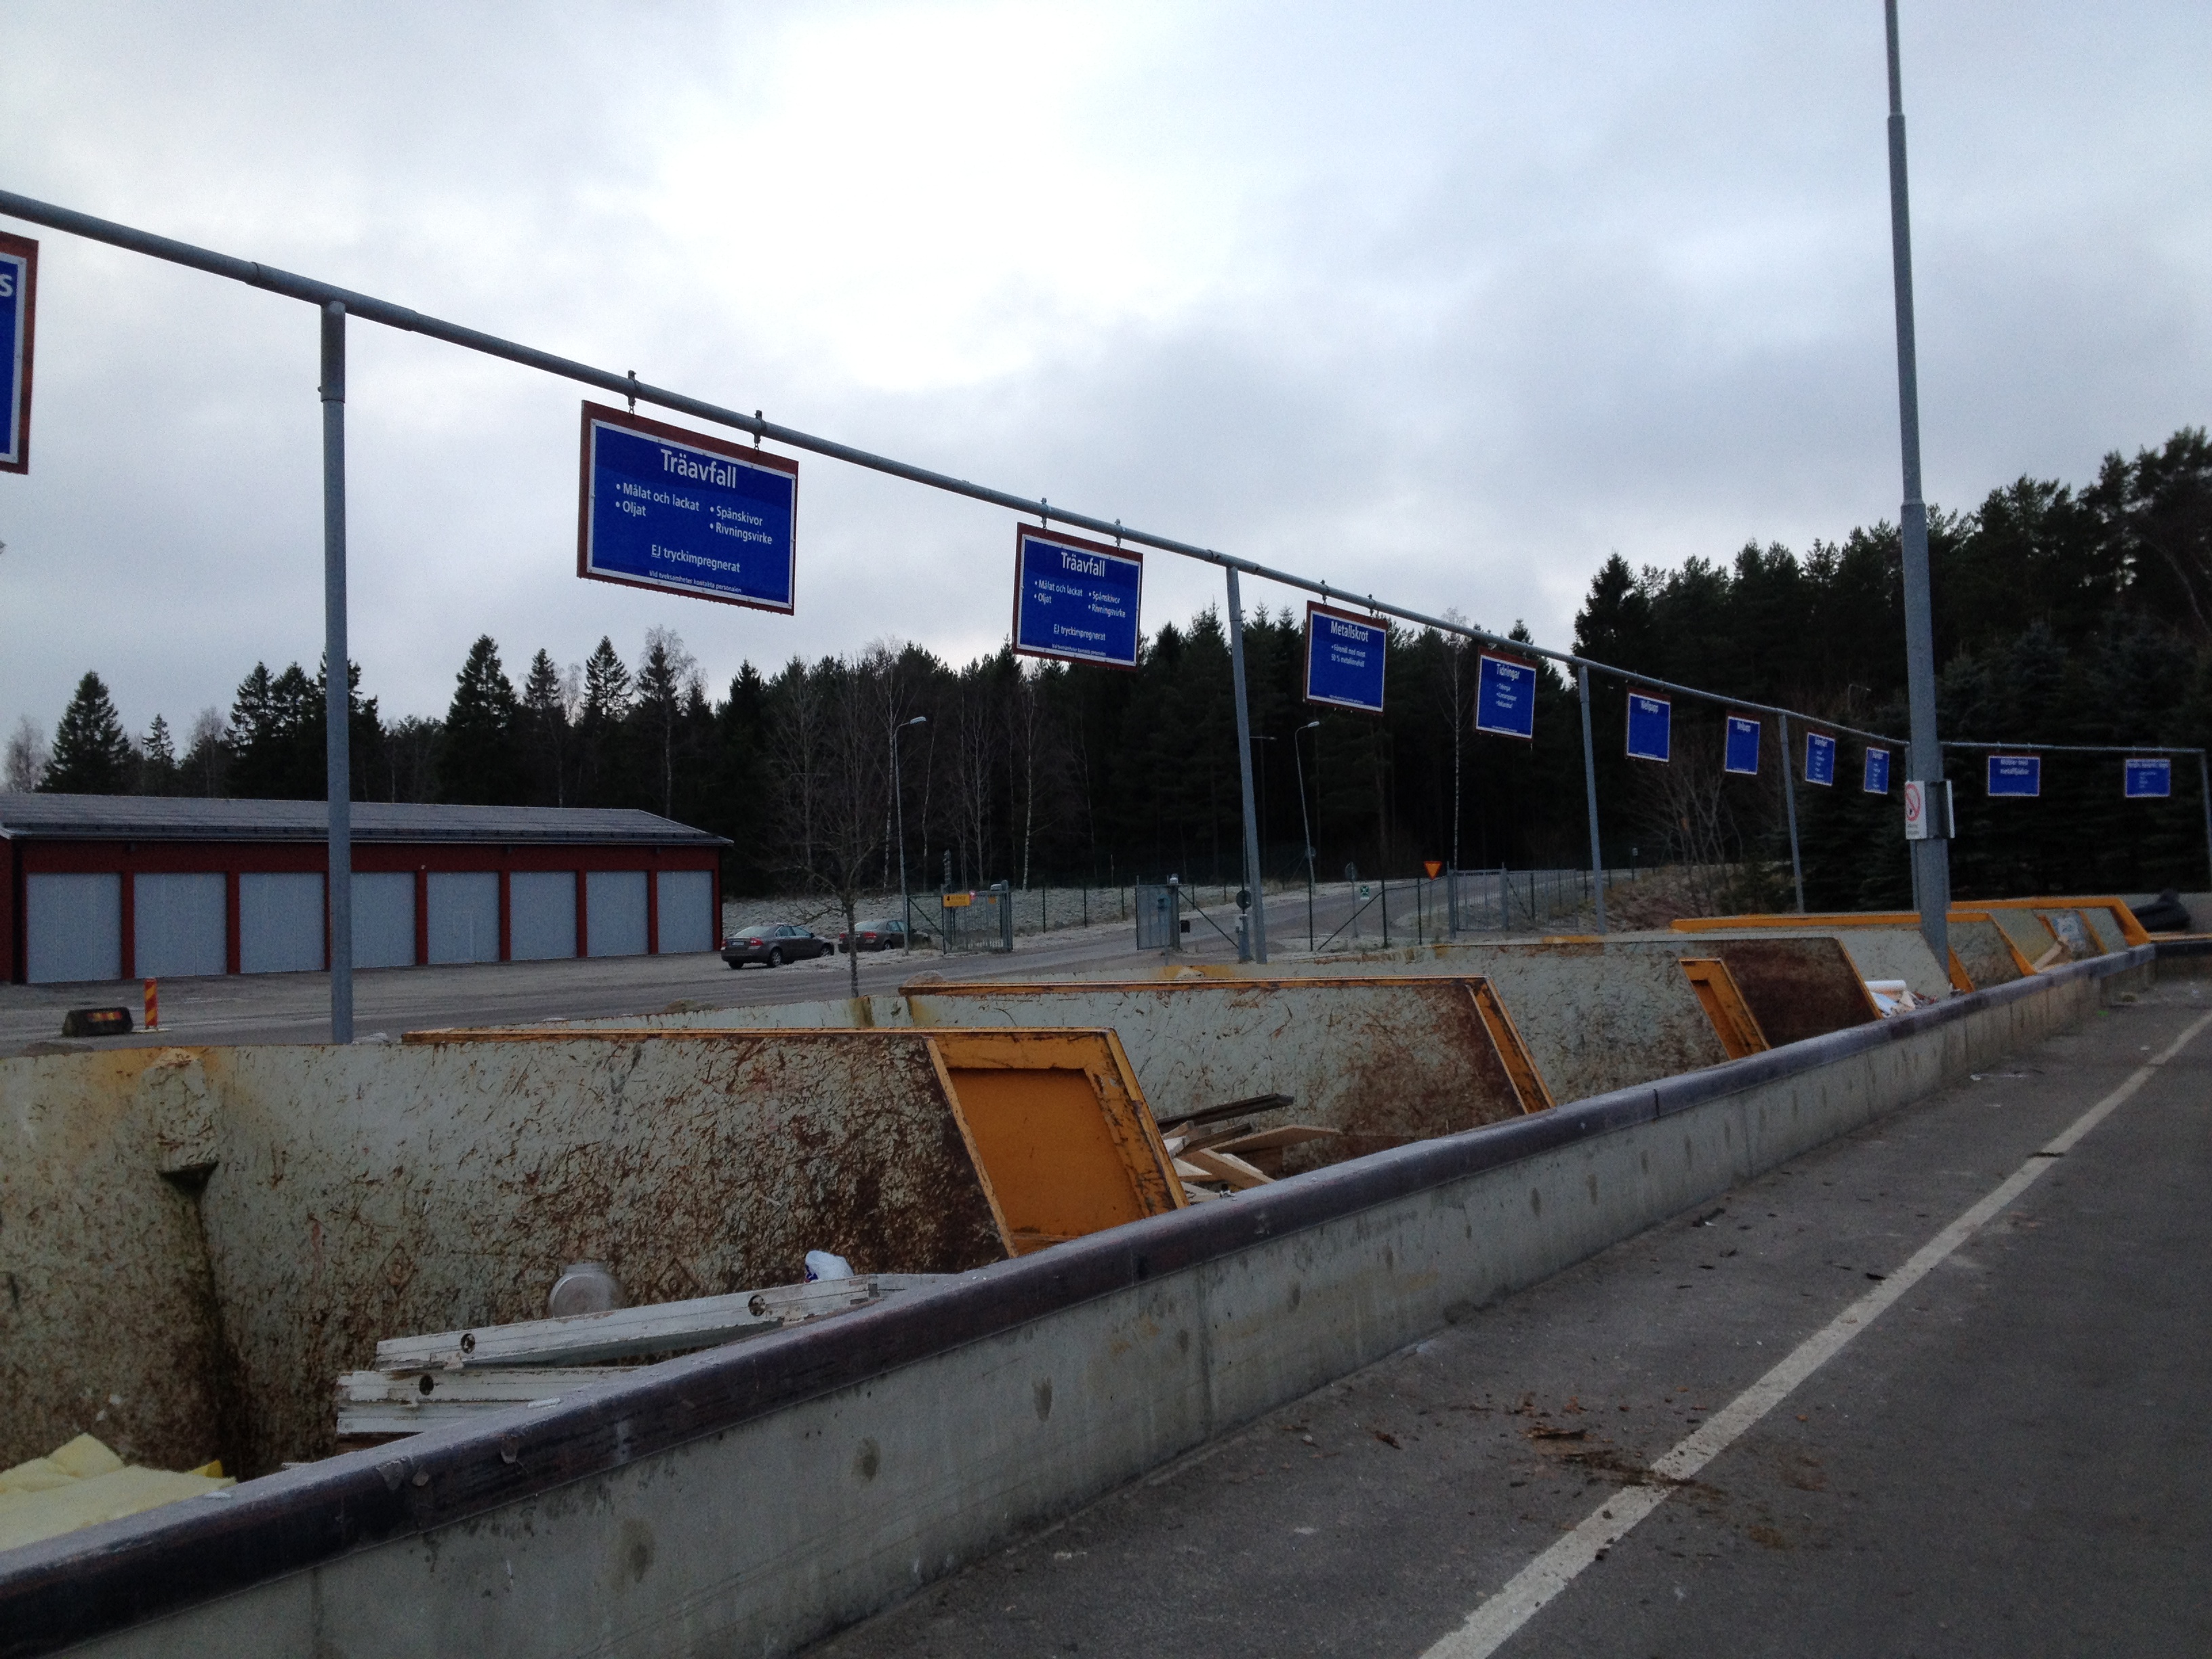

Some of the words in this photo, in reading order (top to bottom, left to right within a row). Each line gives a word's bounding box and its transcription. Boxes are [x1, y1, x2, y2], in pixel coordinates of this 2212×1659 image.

[660, 448, 737, 489] Träavfall
[623, 483, 651, 500] Målat
[653, 492, 670, 505] och
[672, 494, 700, 512] lackat
[622, 501, 647, 517] Oljat
[716, 506, 763, 527] Spånskivor
[716, 522, 773, 545] Rivningsvirke
[663, 548, 740, 573] tryckimpregnerat
[1061, 552, 1105, 577] Träavfall
[649, 570, 658, 578] Vid
[1038, 579, 1055, 592] Målat
[1056, 585, 1066, 594] och
[1067, 585, 1083, 597] lackat
[1038, 592, 1052, 605] Oljat
[1330, 621, 1369, 642] Metallskrot
